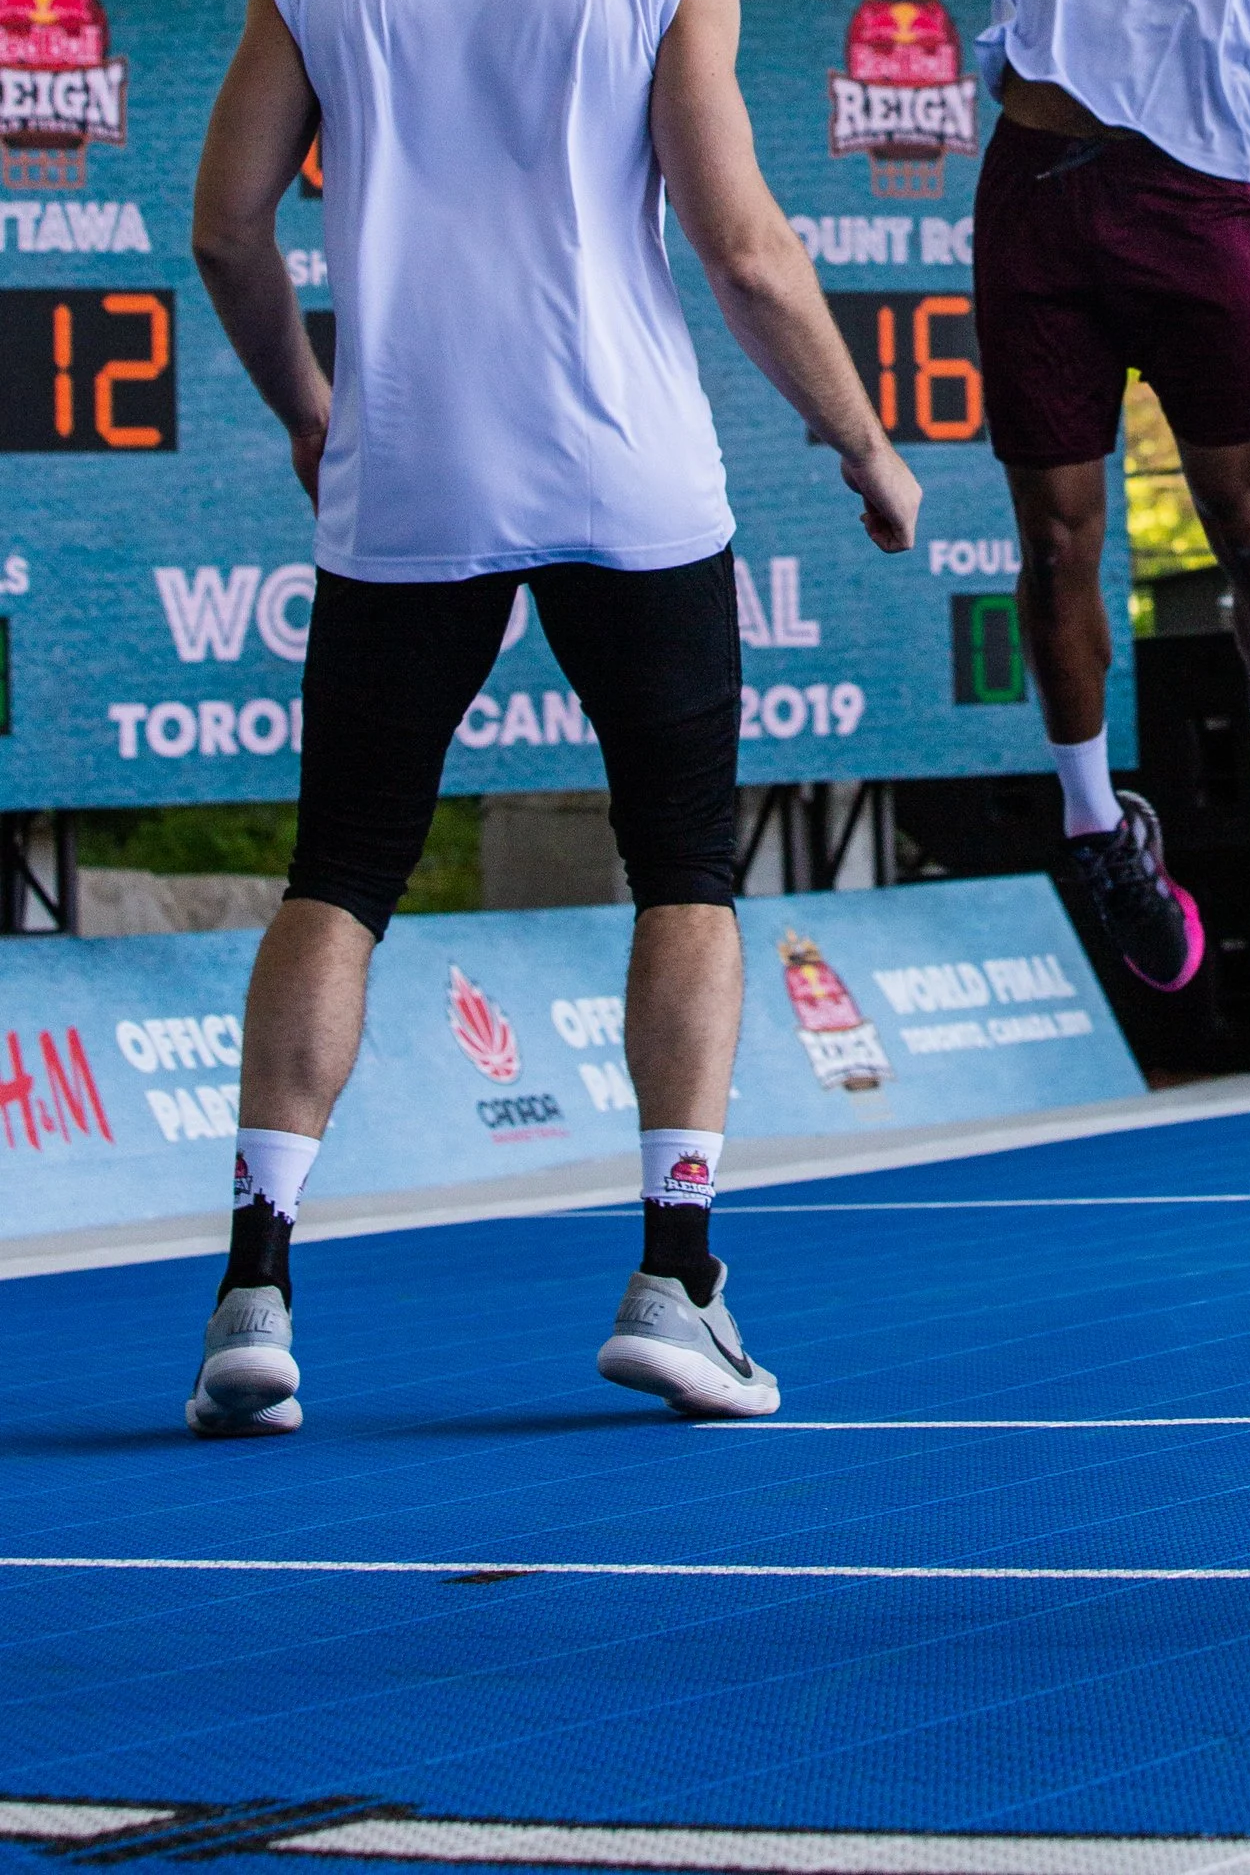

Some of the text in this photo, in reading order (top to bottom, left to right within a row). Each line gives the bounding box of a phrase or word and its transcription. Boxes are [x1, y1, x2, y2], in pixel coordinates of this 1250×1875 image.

[832, 78, 977, 141] REIGN
[53, 292, 171, 450] 12
[876, 296, 984, 441] 16
[455, 690, 599, 749] CAN
[739, 682, 865, 740] 2019
